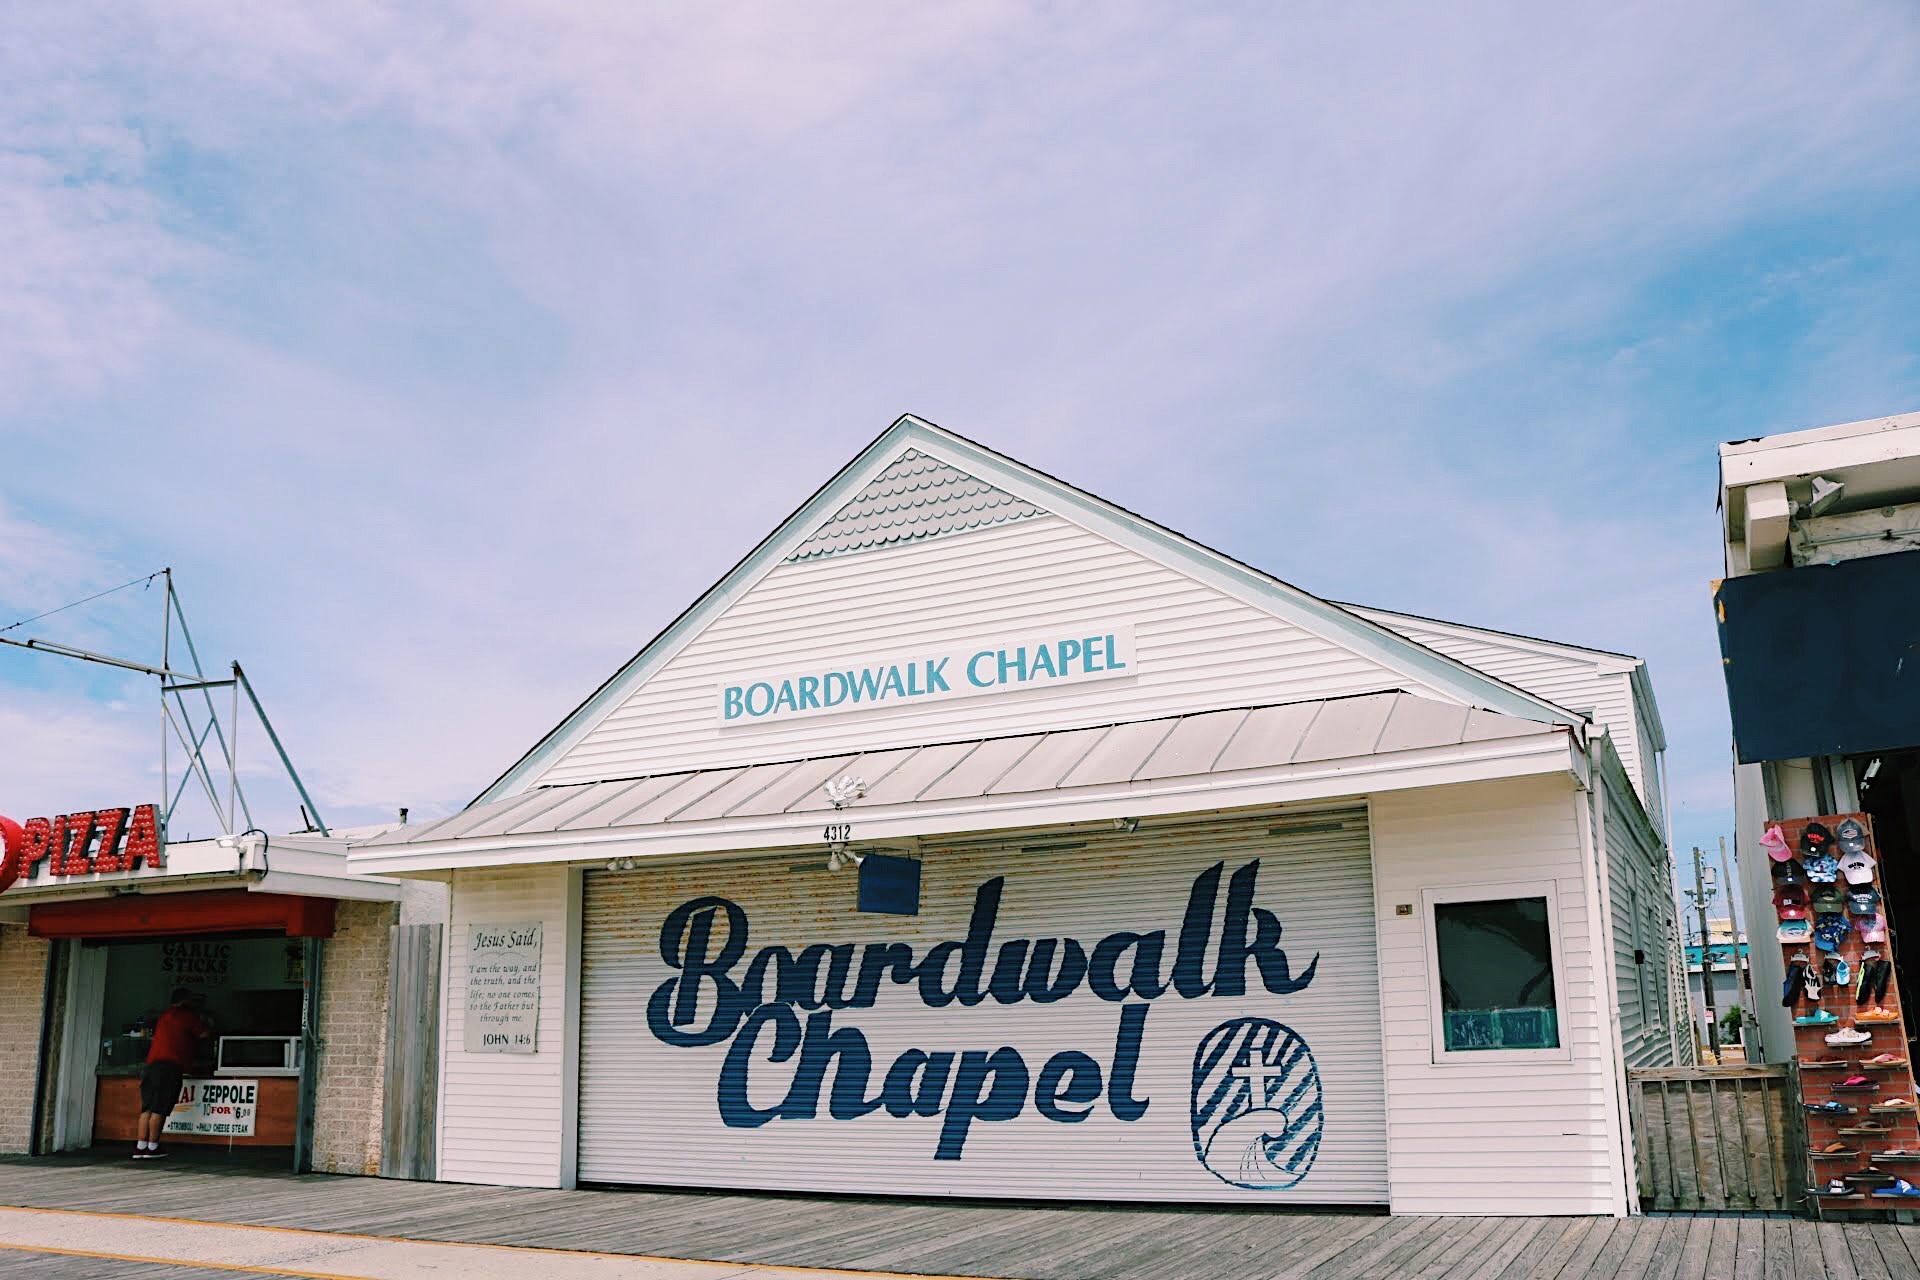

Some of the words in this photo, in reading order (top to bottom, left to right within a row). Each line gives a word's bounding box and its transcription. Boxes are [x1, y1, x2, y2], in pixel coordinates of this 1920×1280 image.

[723, 656, 951, 721] BOARDWALK
[966, 634, 1127, 688] CHAPEL
[18, 803, 166, 879] PIZZA
[823, 824, 851, 841] 4312
[473, 932, 505, 951] Jesus
[507, 927, 538, 949] Said,
[162, 941, 232, 959] GARLIC
[646, 857, 1321, 1048] Boardwalk
[162, 957, 228, 974] STICKS
[476, 966, 488, 974] am
[489, 962, 501, 973] the
[522, 962, 538, 972] and
[470, 975, 482, 985] the
[507, 974, 522, 985] and
[523, 975, 536, 985] the
[487, 991, 496, 999] no
[498, 991, 511, 999] one
[513, 991, 535, 999] comes
[470, 1003, 478, 1011] to
[480, 1000, 492, 1011] the
[493, 1000, 520, 1012] Father
[521, 1000, 535, 1010] but
[480, 1013, 509, 1026] through
[483, 1033, 509, 1047] JOHN
[515, 1033, 531, 1045] 14:6
[717, 1001, 1152, 1161] Chapel
[202, 1084, 255, 1105] ZEPPOLE
[211, 1106, 231, 1115] FOR
[213, 1123, 230, 1133] CHEESE
[231, 1124, 249, 1134] STEAK
